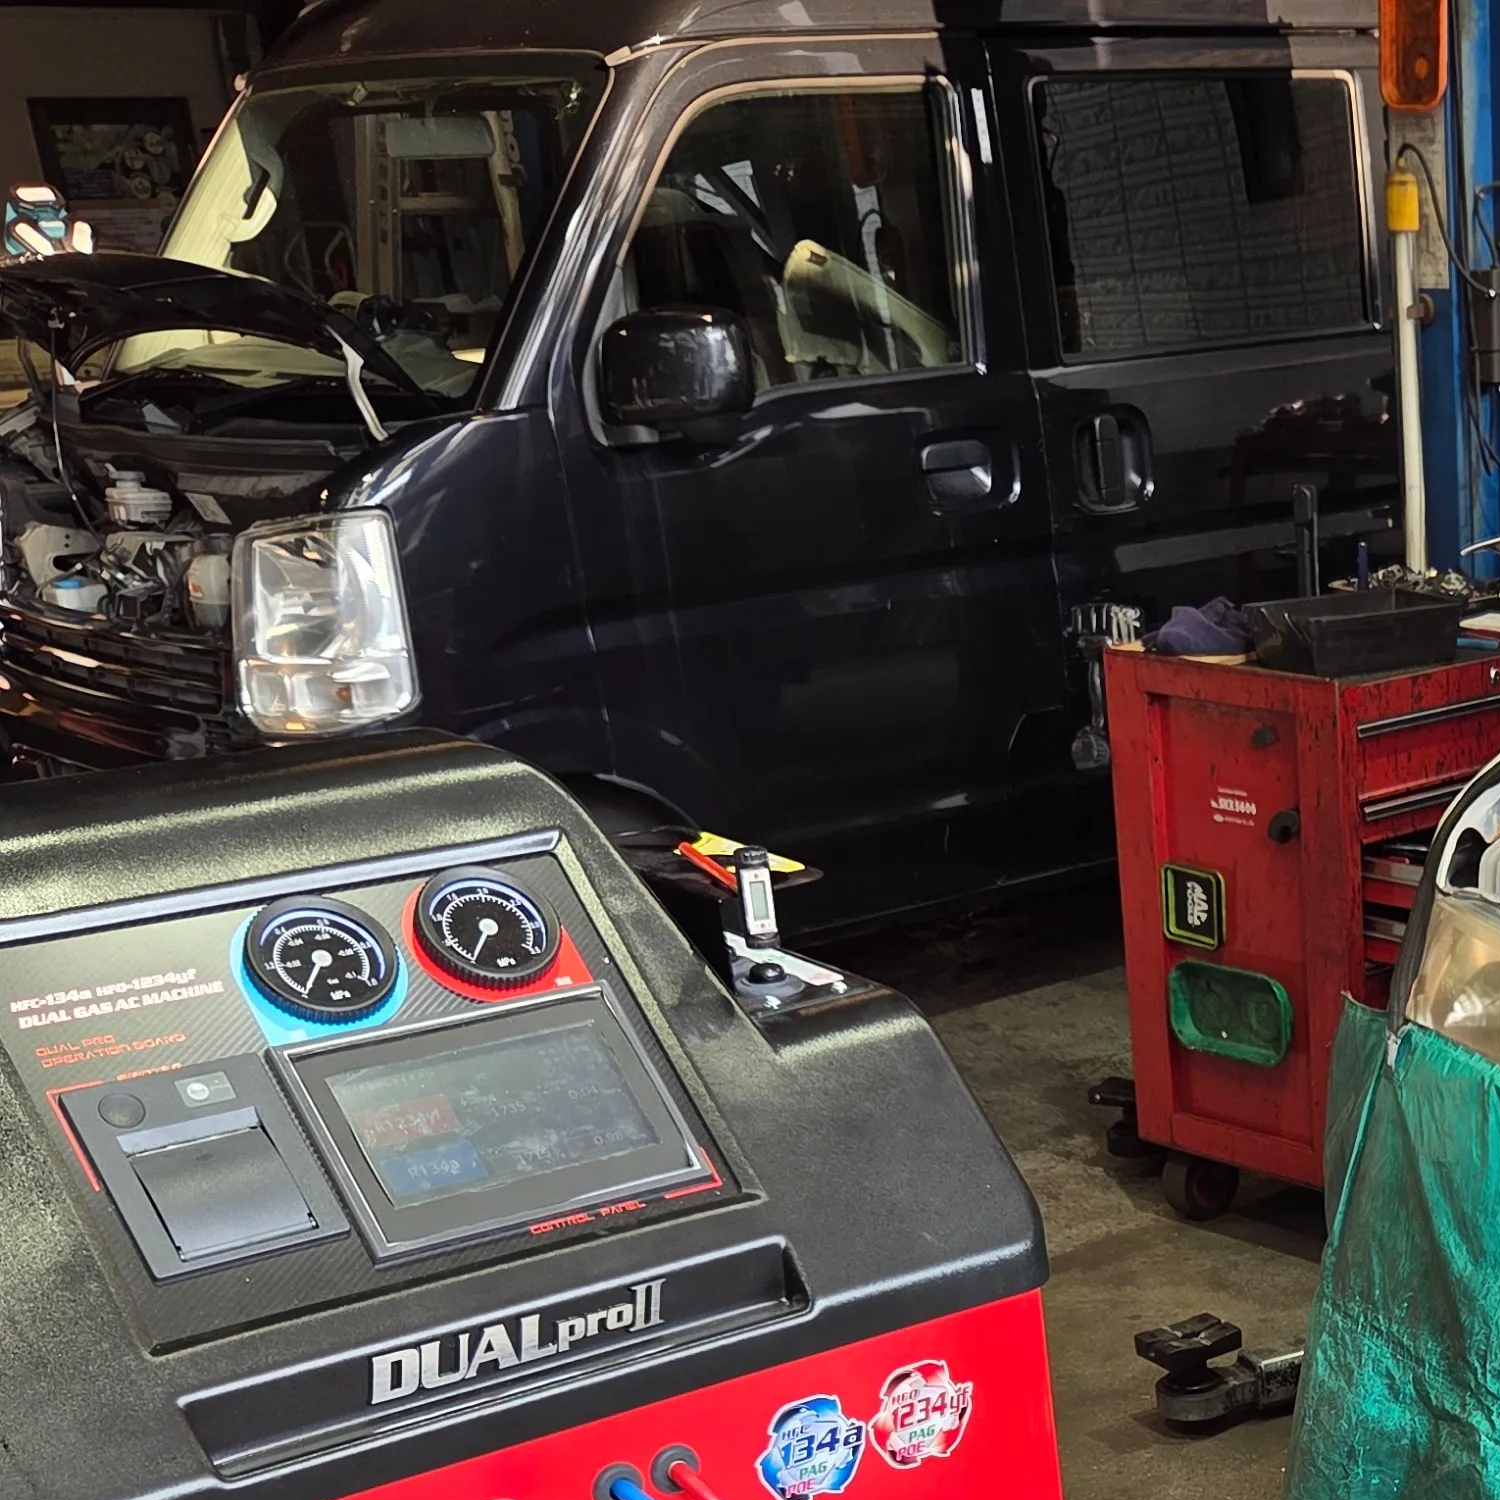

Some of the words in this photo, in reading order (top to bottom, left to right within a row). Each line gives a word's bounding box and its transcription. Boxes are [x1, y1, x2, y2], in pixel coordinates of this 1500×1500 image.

[10, 988, 93, 1013] HFC-134a
[18, 1009, 73, 1030] DUAL
[73, 1001, 114, 1019] GAS
[115, 996, 141, 1012] AC
[142, 979, 225, 1006] MACHINE
[35, 1042, 80, 1057] DUAL
[81, 1033, 116, 1048] PRO
[40, 1043, 132, 1068] OPERATION
[132, 1032, 187, 1051] BOARD
[530, 1212, 596, 1236] CONTROL
[600, 1200, 647, 1217] PANEL
[908, 1424, 936, 1443] PAG
[897, 1440, 926, 1461] POE
[799, 1460, 828, 1481] PAG
[786, 1478, 816, 1498] POE
